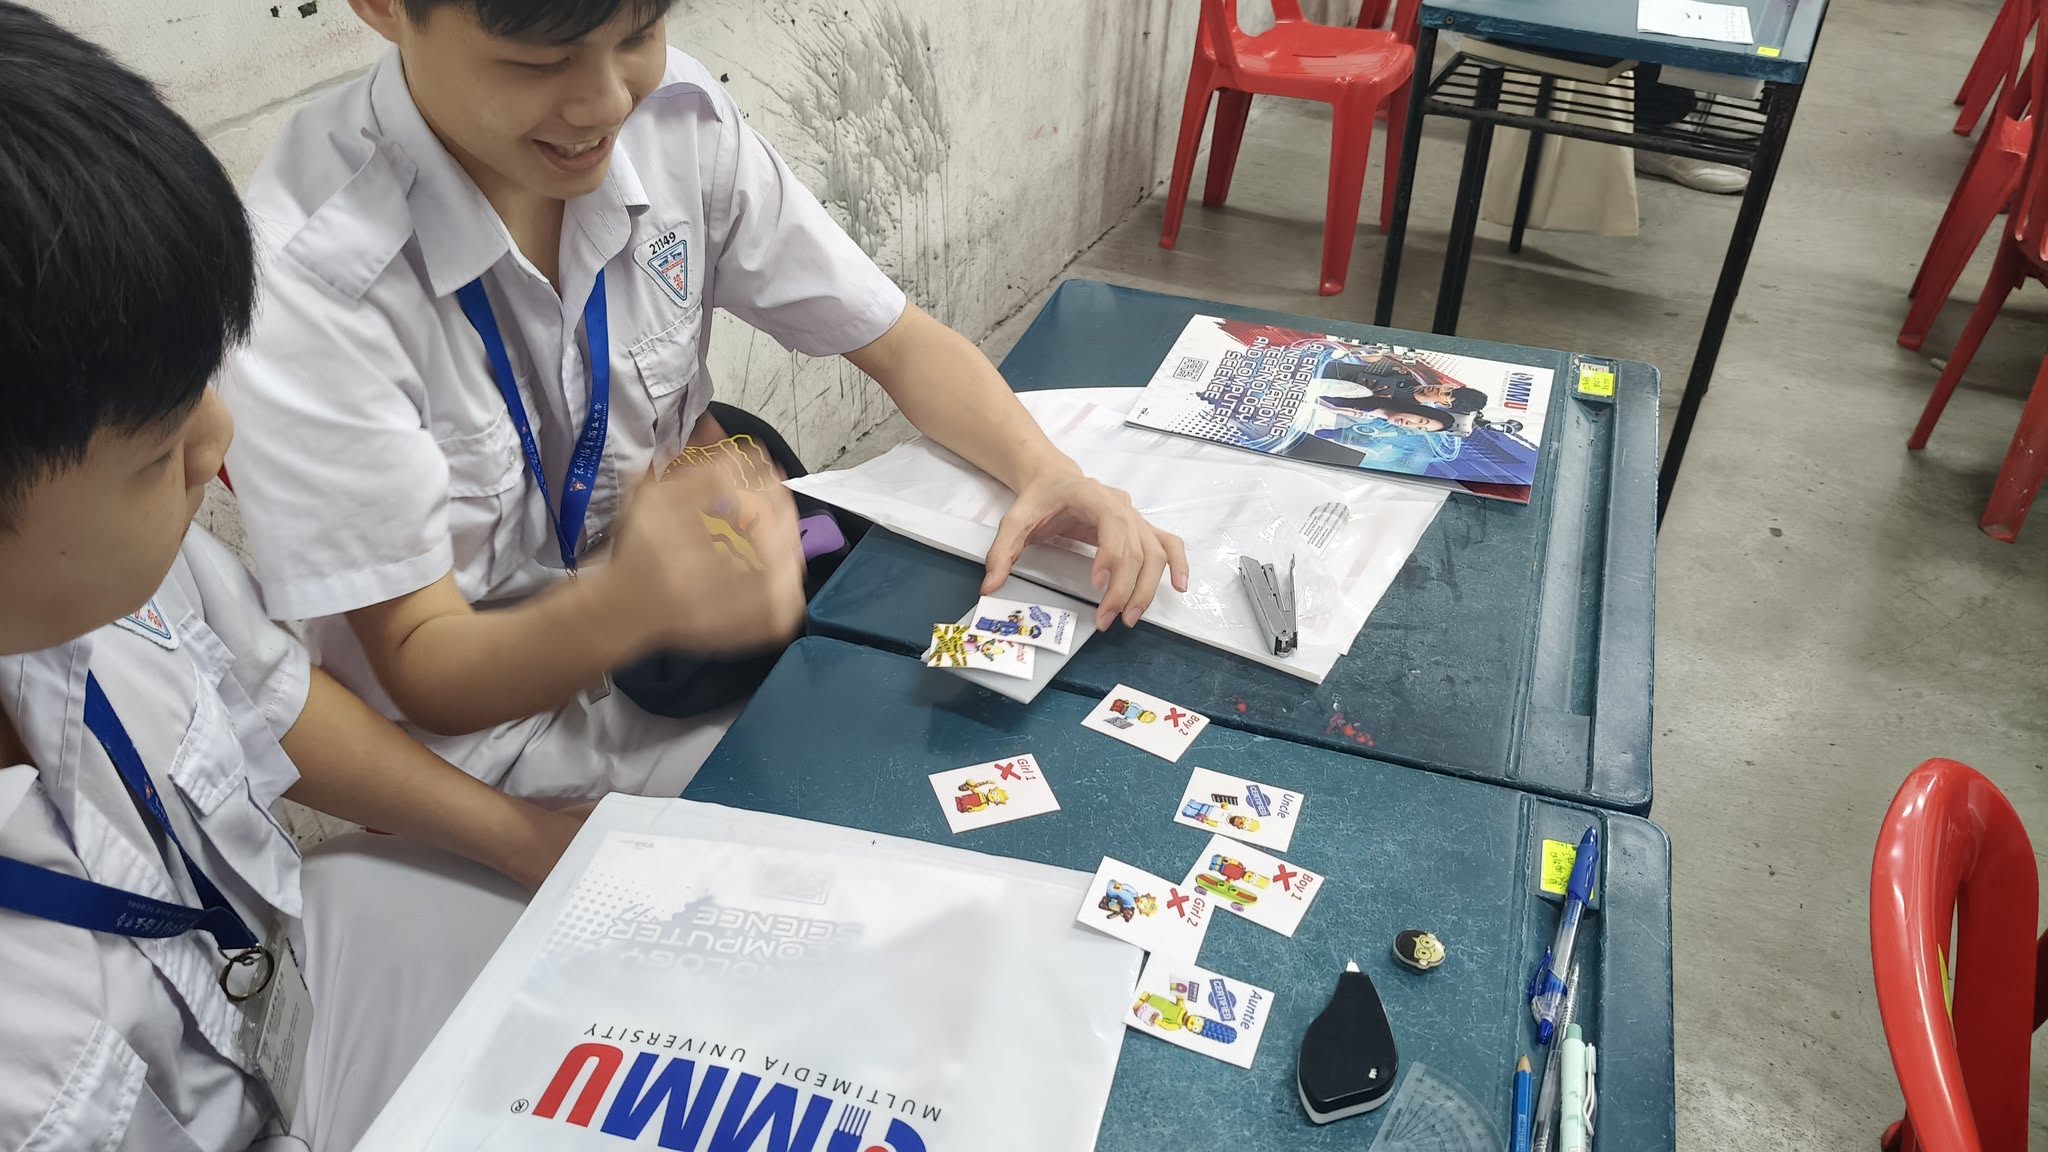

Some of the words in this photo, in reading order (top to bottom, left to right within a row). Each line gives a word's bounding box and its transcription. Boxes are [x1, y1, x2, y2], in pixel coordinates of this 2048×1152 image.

[649, 231, 676, 256] 21149
[1248, 335, 1268, 358] AND
[1206, 350, 1241, 400] SCIENCE
[1238, 345, 1282, 422] TECHNOLOGY
[1255, 346, 1302, 427] INFORMATION
[1214, 358, 1253, 425] COMPUTER
[1268, 356, 1317, 438] ENGINEERING,
[1504, 379, 1531, 409] MMU
[1179, 728, 1189, 736] 2
[1183, 714, 1200, 729] Boy
[1017, 758, 1034, 775] Girl
[1277, 793, 1295, 819] Uncle
[1291, 892, 1303, 901] 1
[1294, 873, 1314, 896] Boy
[1190, 897, 1205, 918] Girl
[1187, 918, 1199, 927] 2
[1212, 981, 1233, 1020] CERTIFIED
[1240, 989, 1263, 1030] Auntie
[584, 1023, 746, 1063] UNIVERSITY
[764, 1056, 942, 1122] MULTIMEDIA
